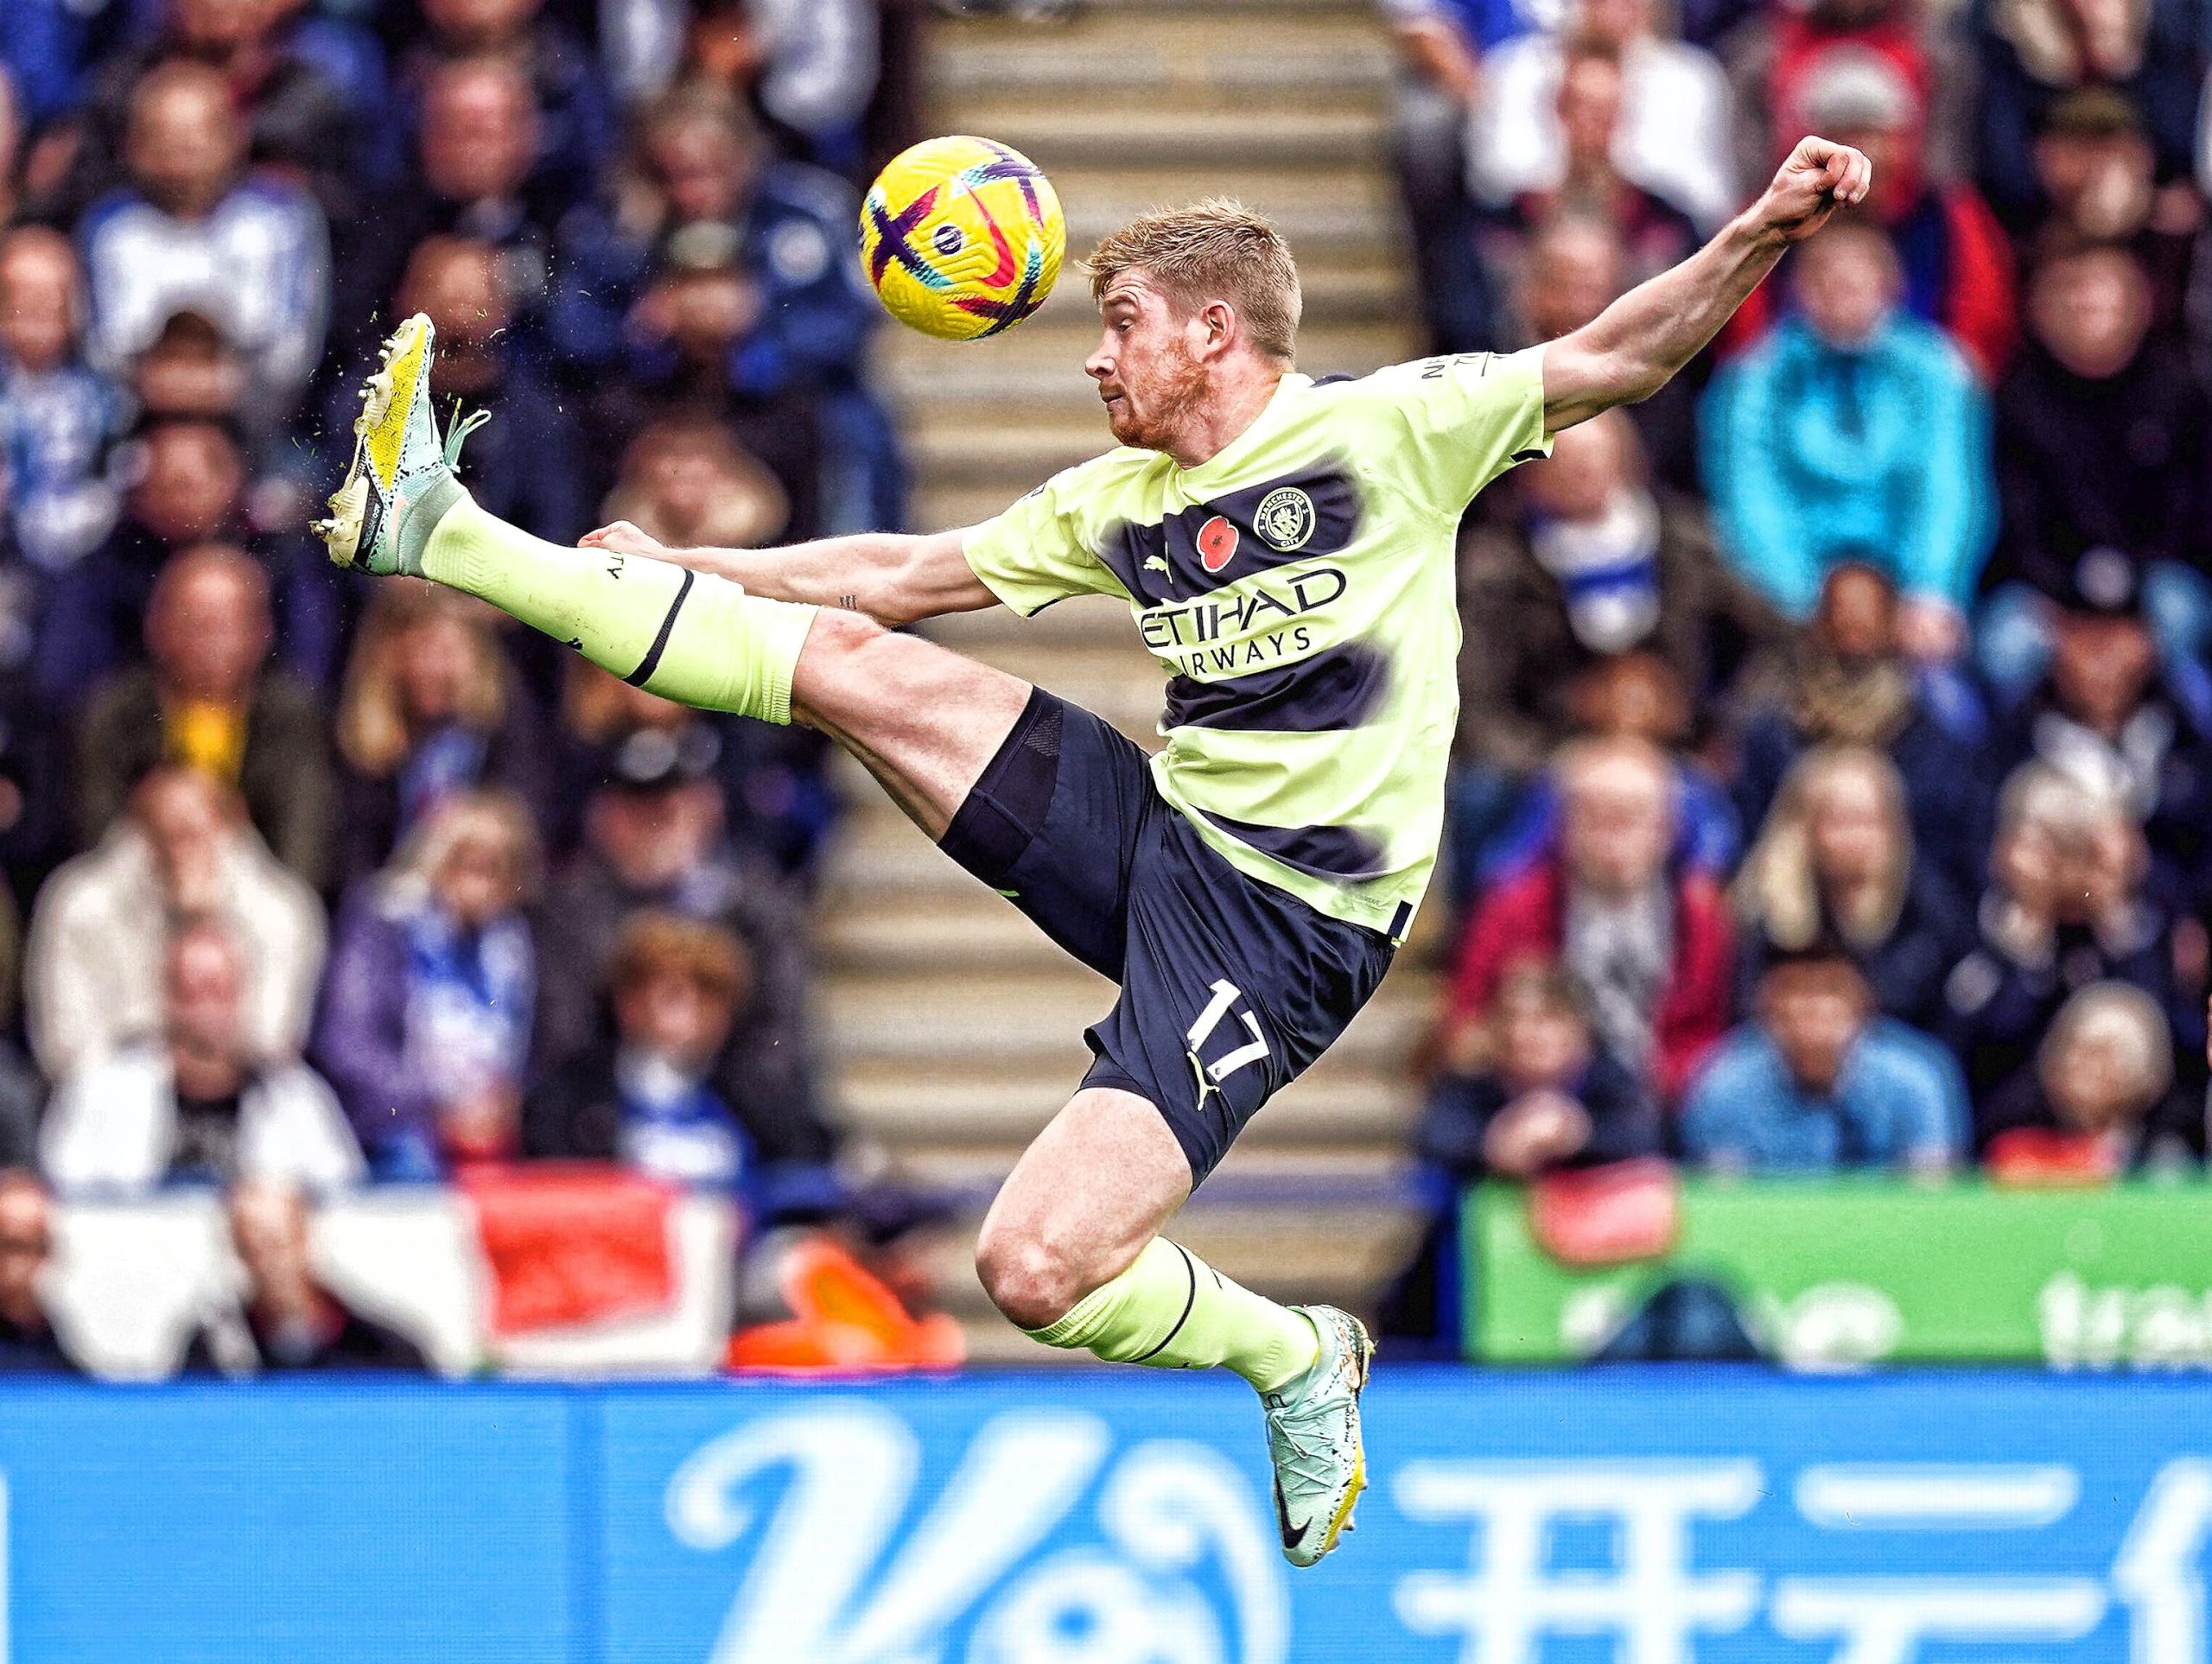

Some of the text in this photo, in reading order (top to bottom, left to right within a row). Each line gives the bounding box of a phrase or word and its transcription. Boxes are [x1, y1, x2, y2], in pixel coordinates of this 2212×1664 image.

[607, 550, 624, 579] ITY
[1280, 537, 1300, 547] CITY
[1140, 568, 1347, 648] ETIHAD
[1179, 626, 1311, 676] IRWAYS
[1186, 978, 1270, 1083] 17
